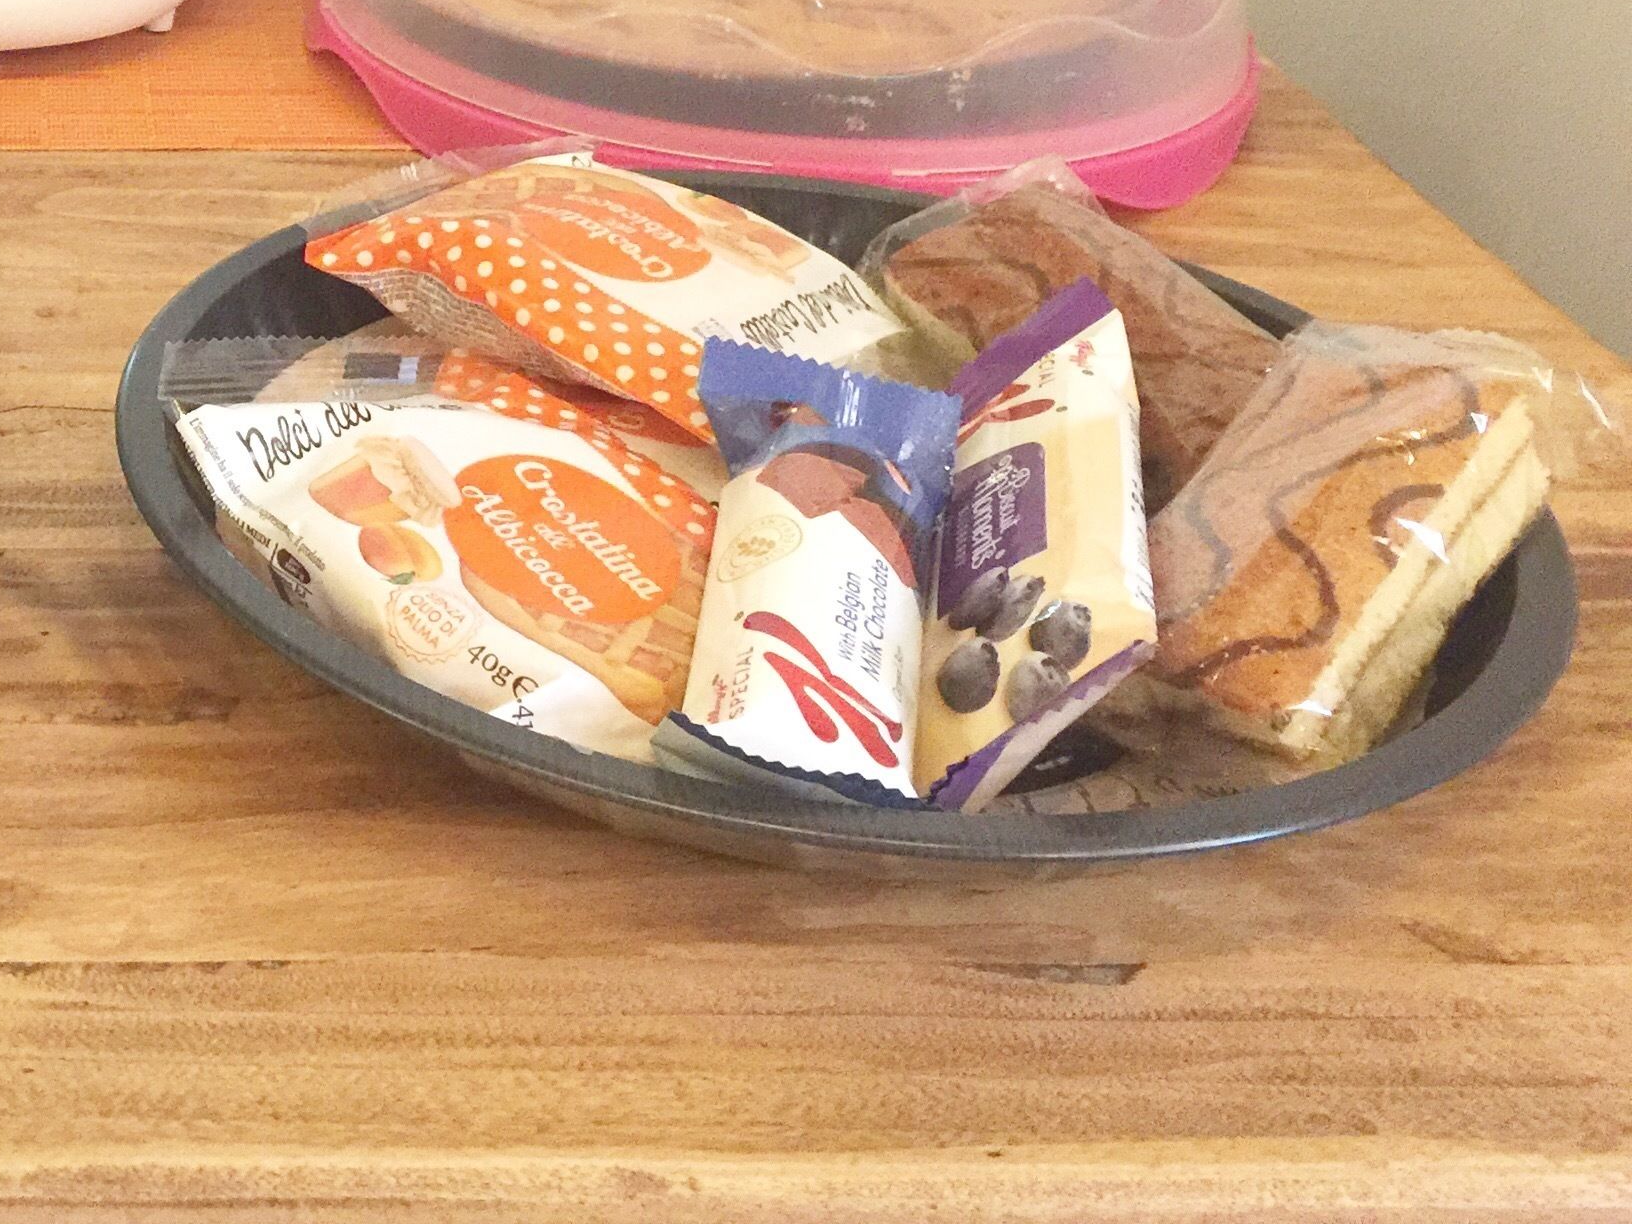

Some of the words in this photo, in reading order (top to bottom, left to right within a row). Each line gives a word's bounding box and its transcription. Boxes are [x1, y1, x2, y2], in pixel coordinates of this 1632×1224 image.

[235, 408, 323, 483] Dolci
[460, 484, 595, 616] Albicocca
[513, 460, 664, 601] Crostatina
[400, 605, 440, 649] PALMA
[833, 570, 866, 634] Belgian
[862, 558, 890, 642] Chocolate
[728, 645, 755, 721] SPECIAL
[858, 640, 881, 683] Milk
